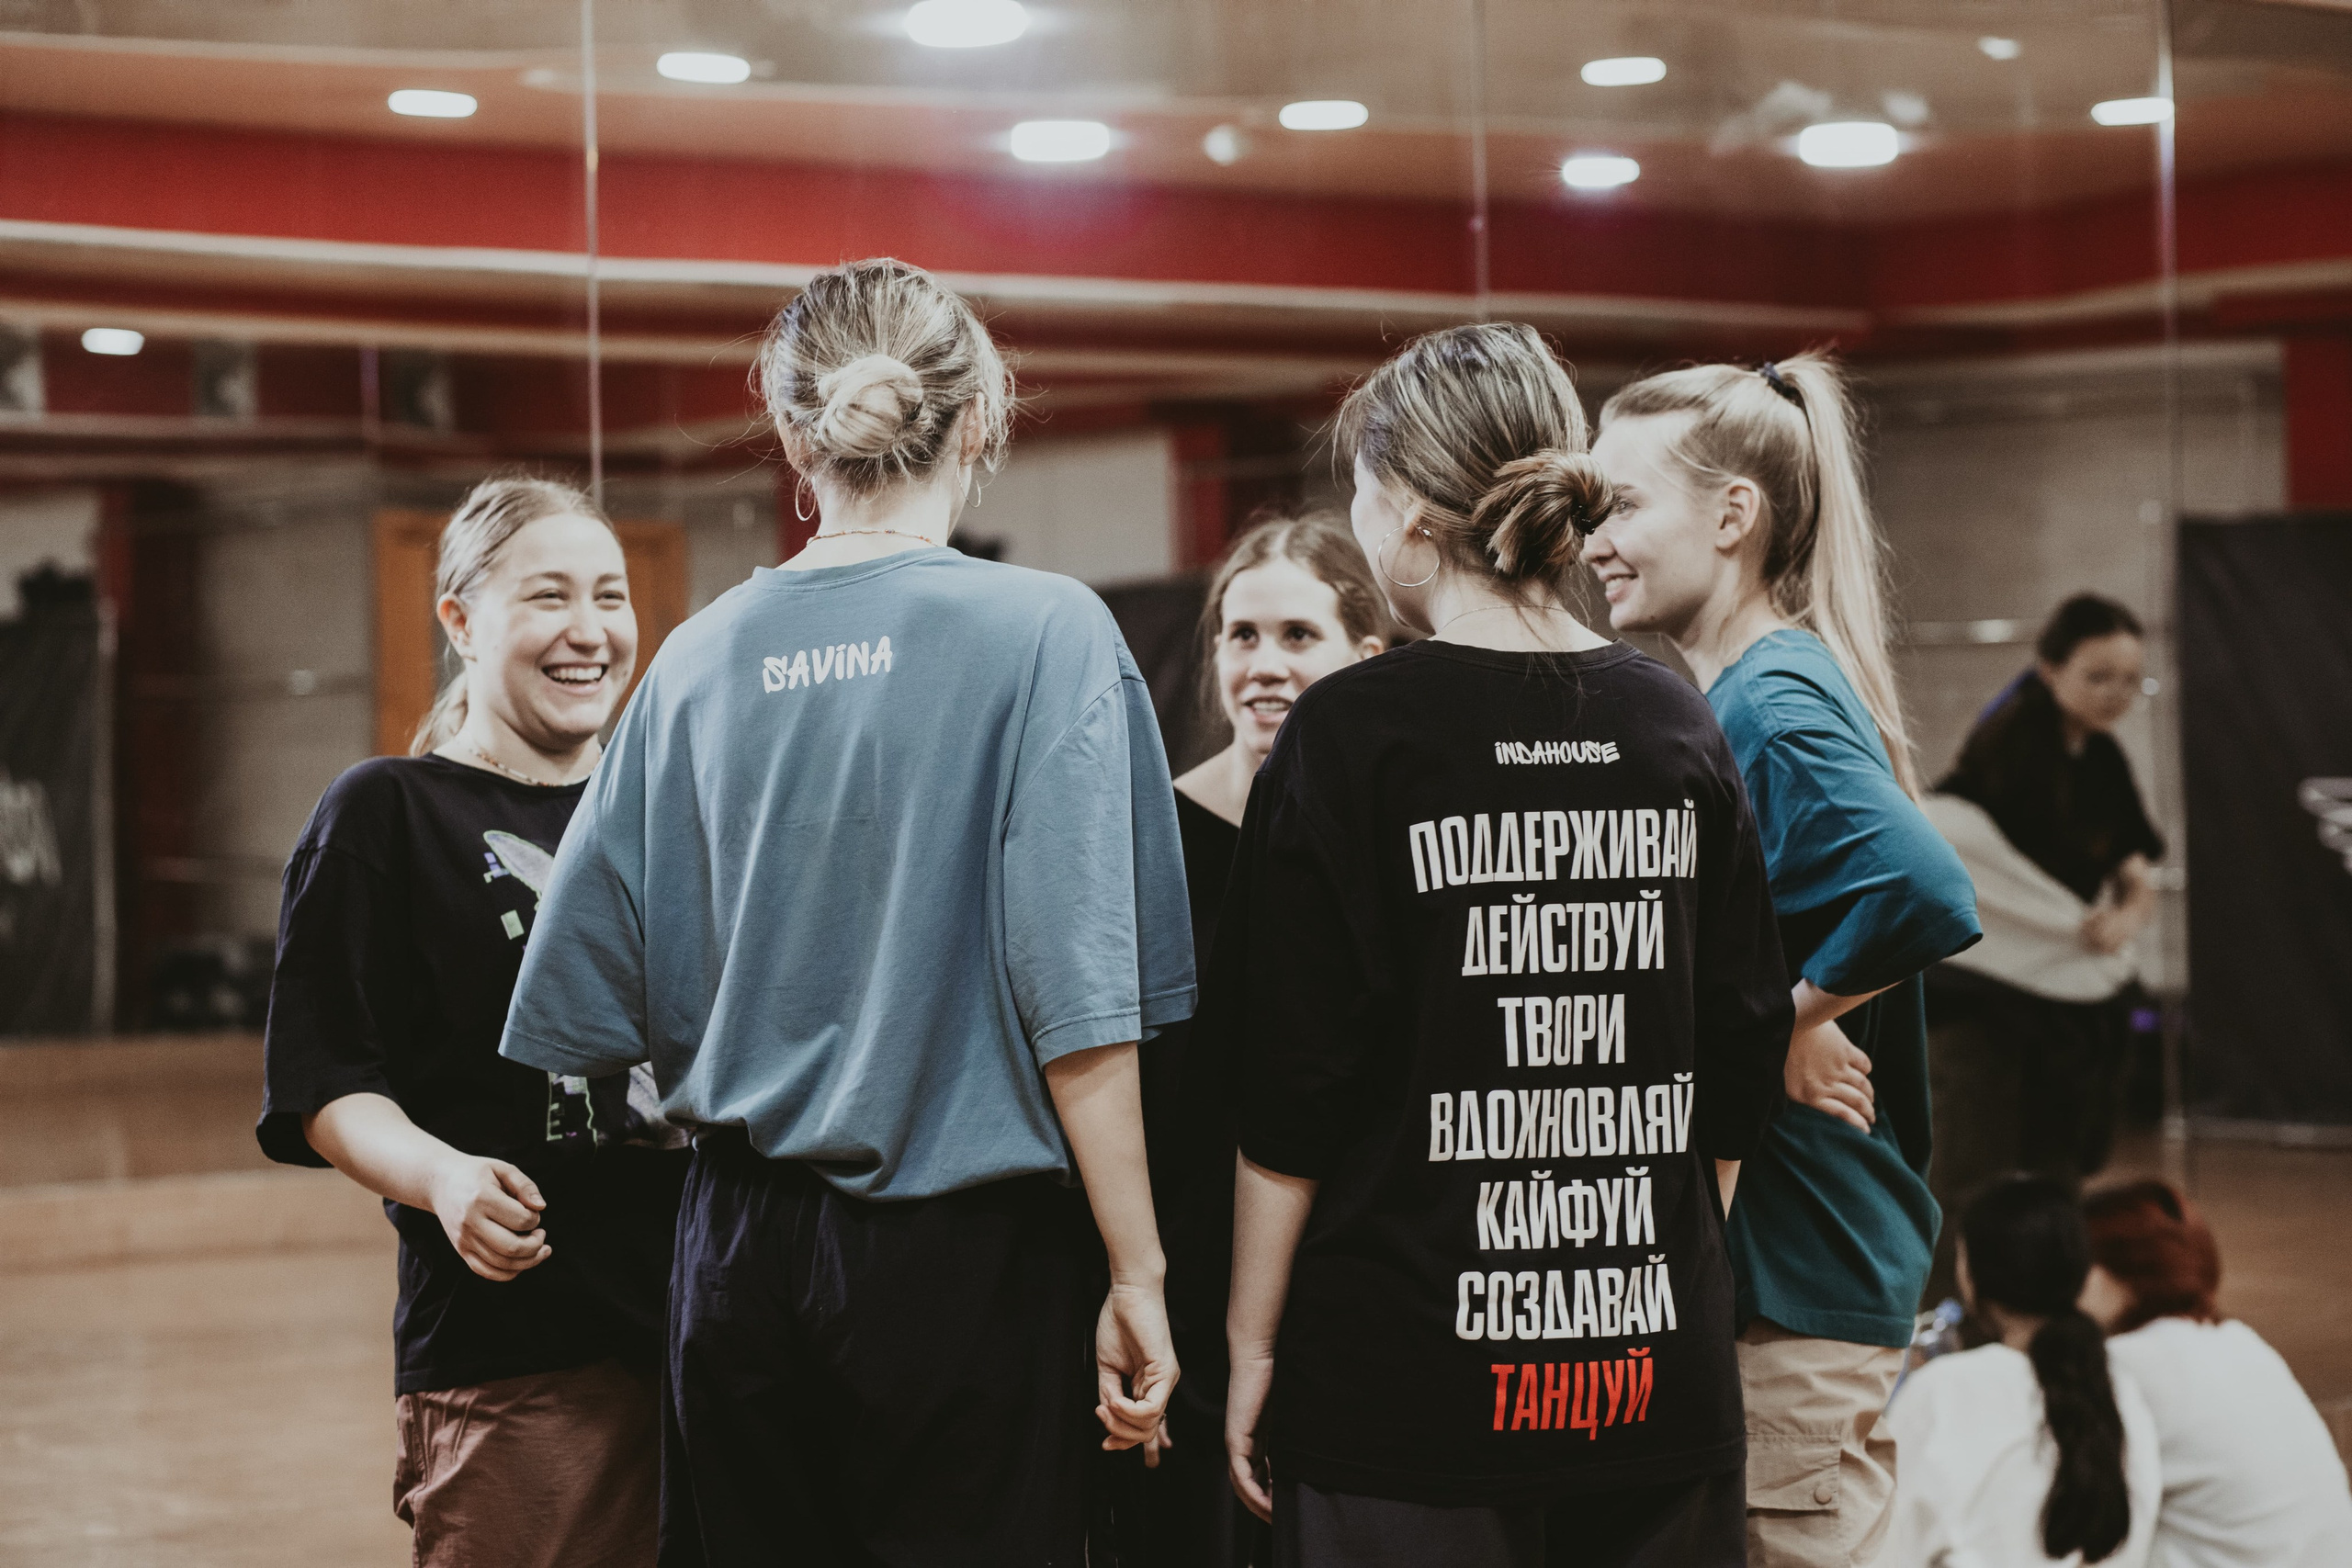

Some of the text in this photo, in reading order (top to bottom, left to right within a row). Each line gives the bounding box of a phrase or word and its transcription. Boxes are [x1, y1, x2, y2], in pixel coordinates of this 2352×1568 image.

[1408, 798, 1697, 894] ПОДДЕРЖИВАЙ
[1461, 889, 1665, 976] ДЕЙСТВУЙ
[1497, 993, 1625, 1067] ТВОРИ
[1428, 1071, 1694, 1162] ВДОХНОВЛЯЙ
[1476, 1166, 1656, 1250] КАЙФУЙ
[1455, 1253, 1678, 1341] СОЗДАВАЙ
[1490, 1347, 1654, 1441] ТАНЦУЙ
